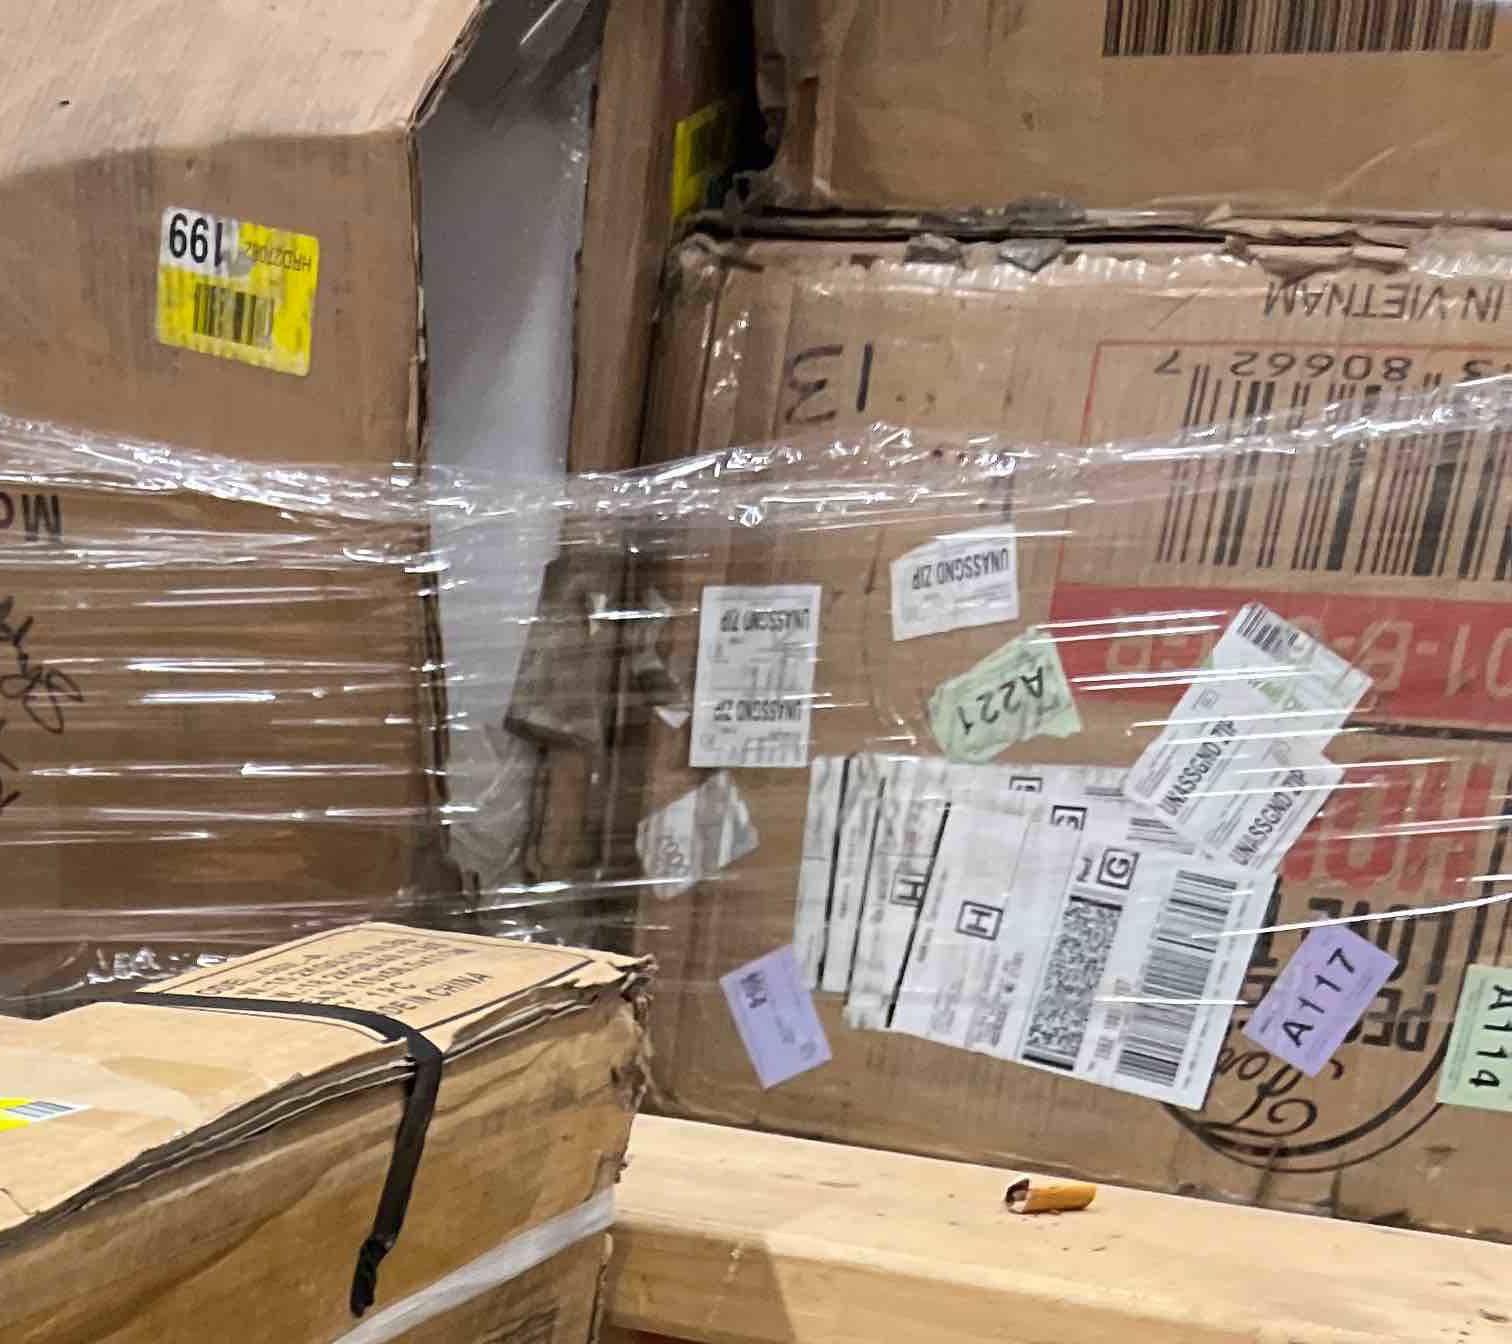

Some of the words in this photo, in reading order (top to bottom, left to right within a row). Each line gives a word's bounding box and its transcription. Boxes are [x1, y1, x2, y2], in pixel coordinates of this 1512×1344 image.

[167, 213, 225, 269] 199
[909, 562, 932, 590] ZIP
[934, 547, 1008, 584] UNASSGND
[956, 663, 1047, 736] A221
[1159, 742, 1222, 817] UNASSGND
[1229, 792, 1293, 867] UNASSGND
[1282, 947, 1355, 1047] A117
